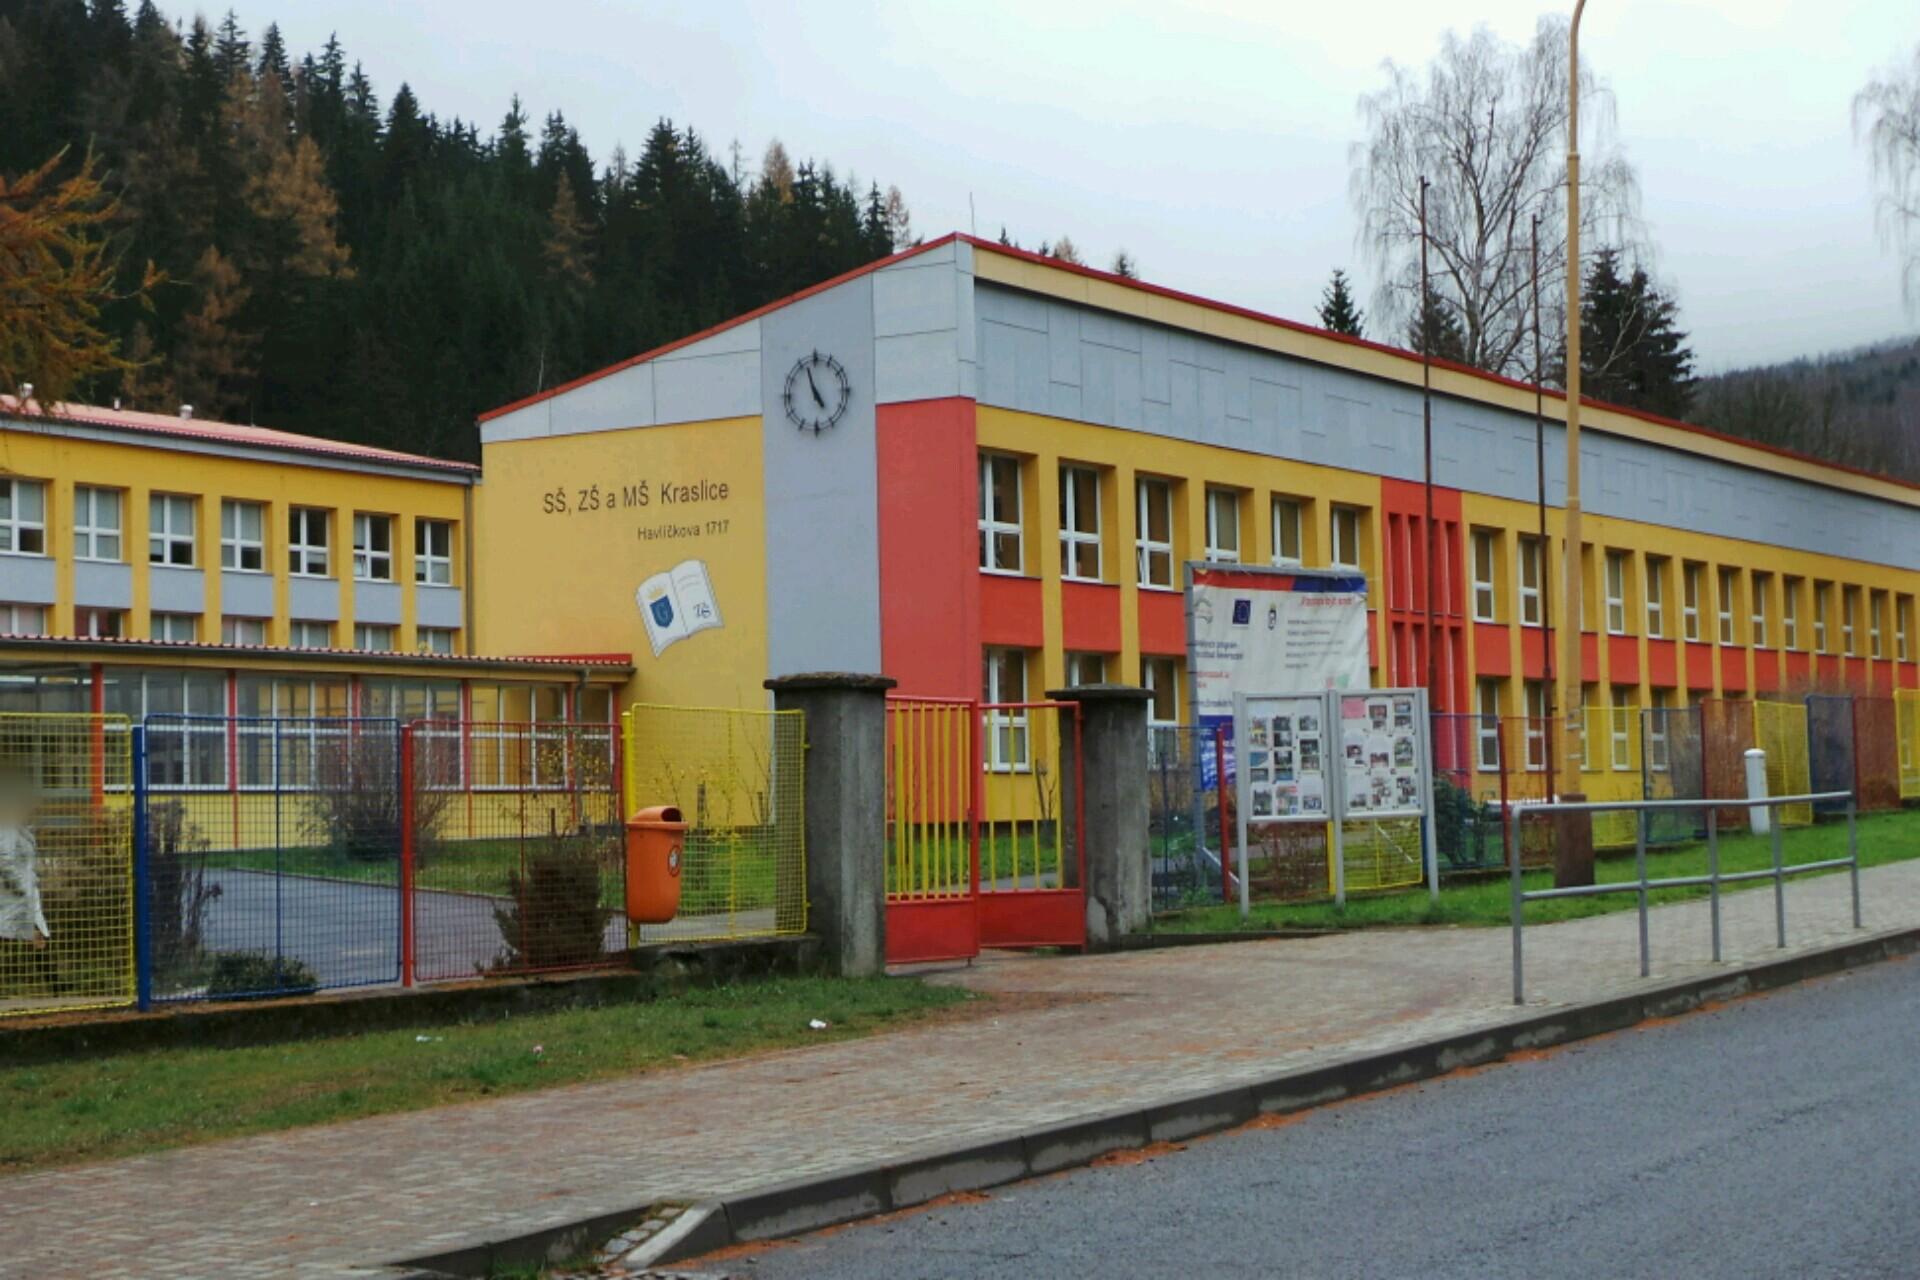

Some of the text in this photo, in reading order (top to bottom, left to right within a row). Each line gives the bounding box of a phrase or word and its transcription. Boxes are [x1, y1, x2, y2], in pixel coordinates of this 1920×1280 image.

[543, 479, 729, 515] SŠ, ZŠ a MŠ Kraslice
[637, 519, 729, 540] Havlíčkova 1717
